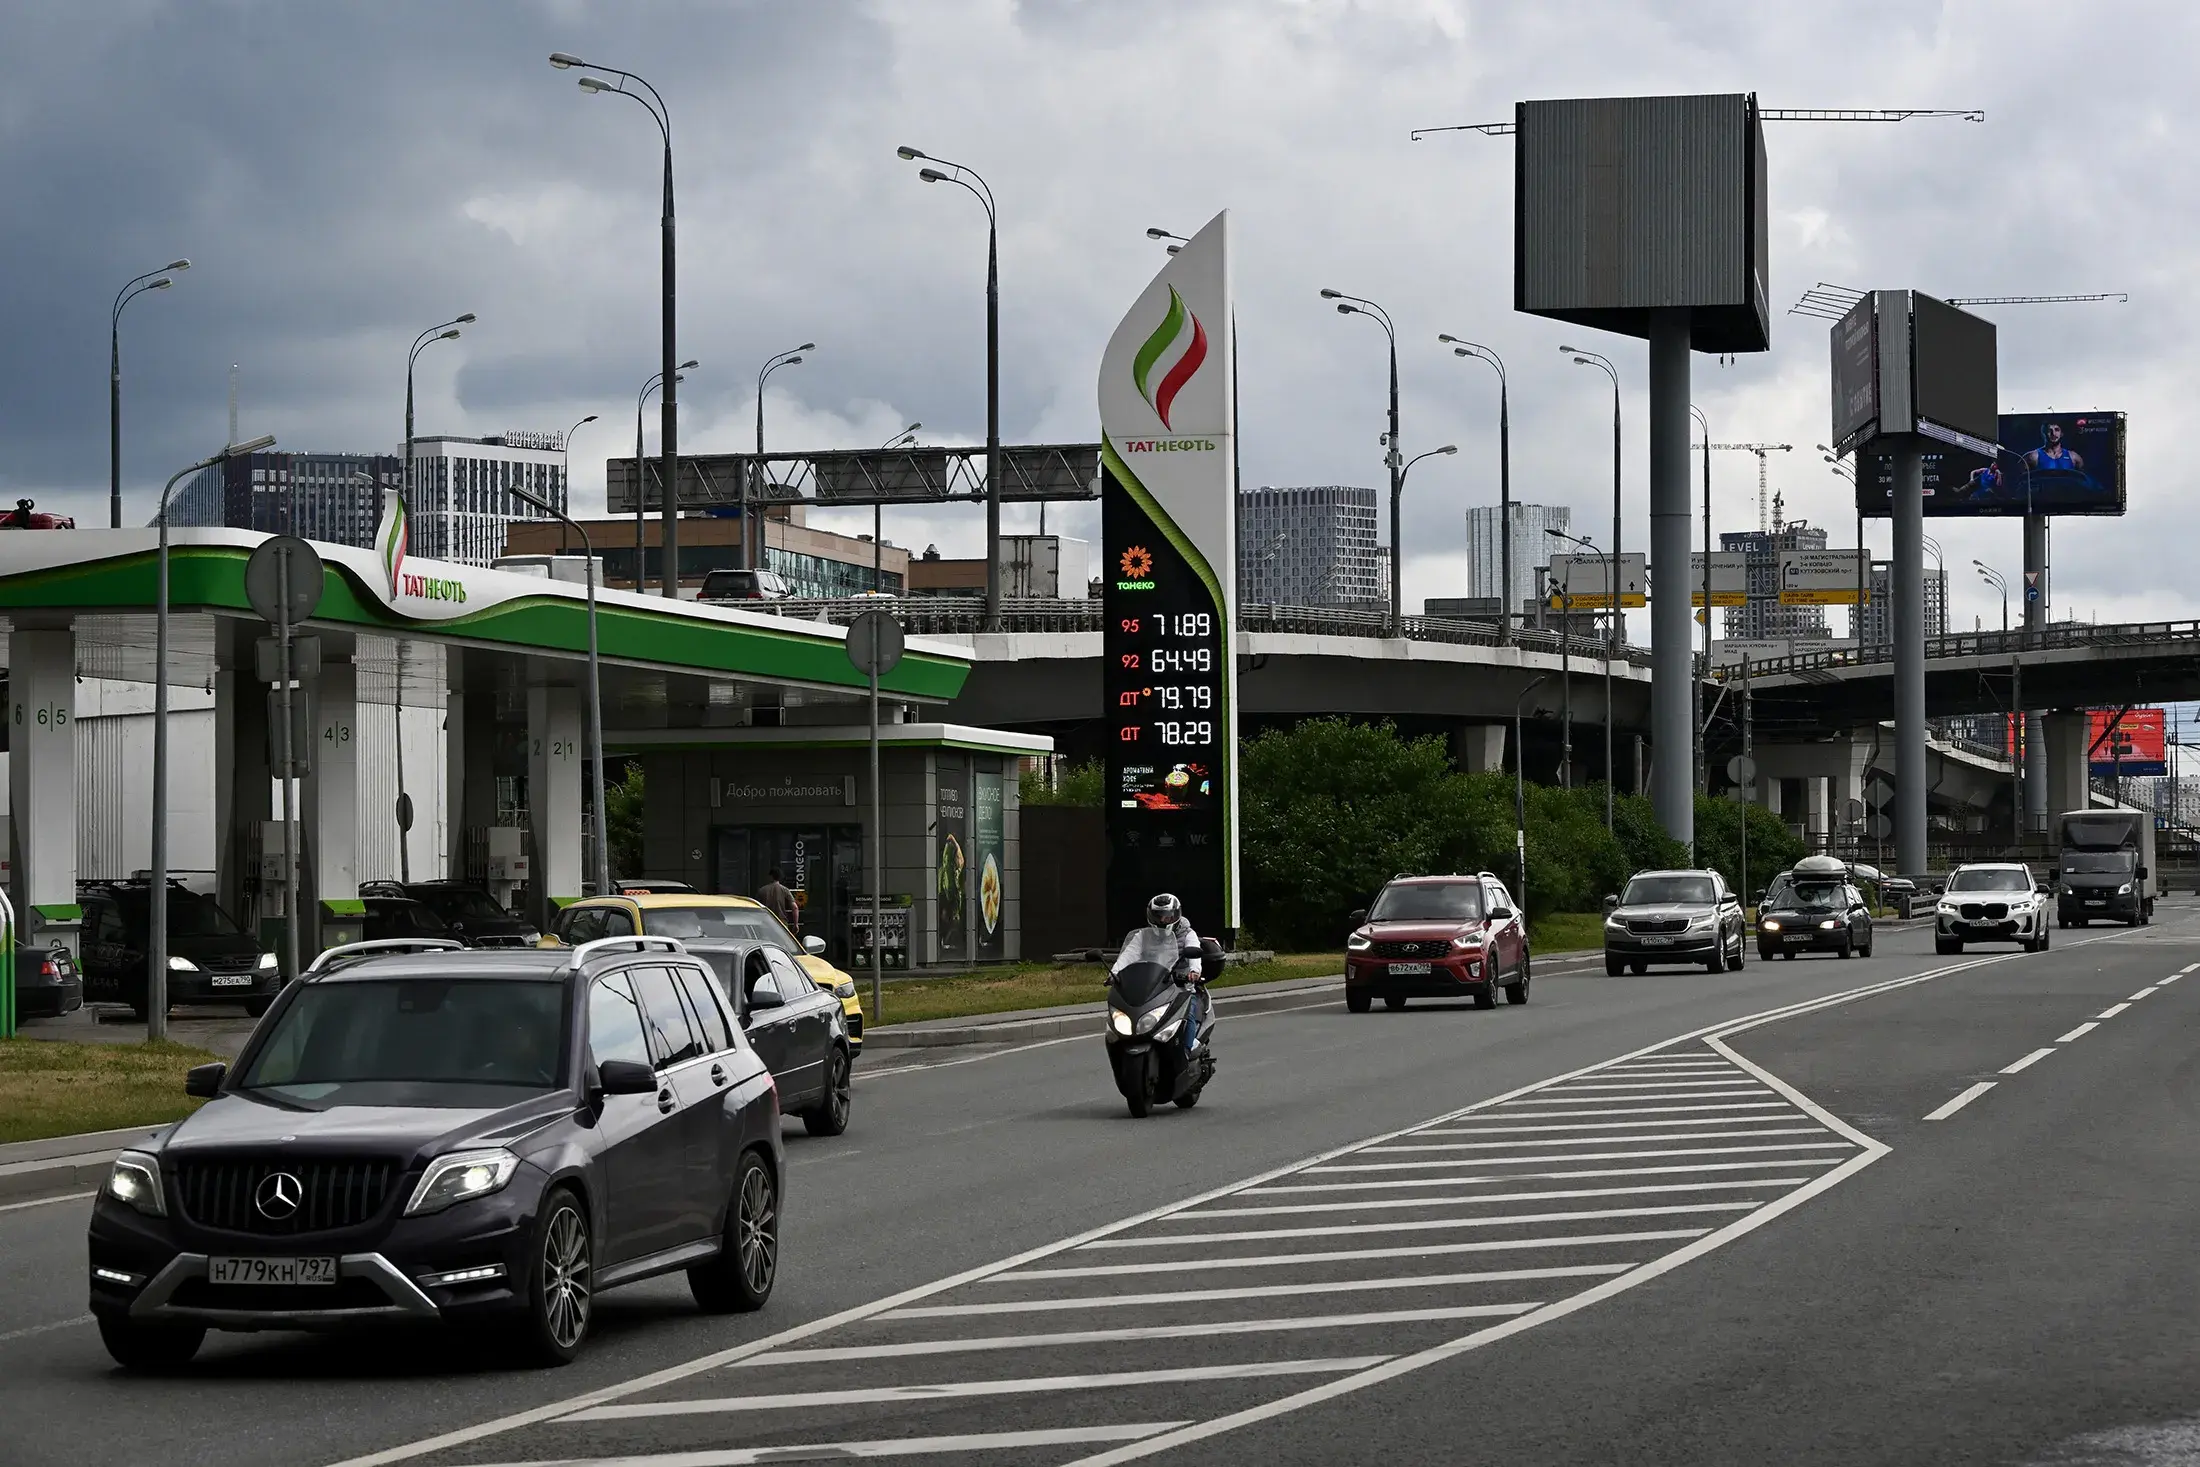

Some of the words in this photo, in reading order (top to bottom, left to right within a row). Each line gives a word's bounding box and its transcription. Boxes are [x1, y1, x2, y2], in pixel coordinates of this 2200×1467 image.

[1125, 440, 1216, 453] ТАТНЕФТЬ
[1722, 542, 1760, 552] LEVEL
[403, 573, 467, 603] ТАТНЕФТЬ
[1117, 582, 1155, 590] ТАНЕКО
[1121, 619, 1140, 632] 95
[1153, 613, 1210, 636] 71.89
[1121, 654, 1140, 668] 92
[1151, 648, 1210, 672] 64.49
[1119, 691, 1140, 706] ДТ
[1154, 686, 1211, 709] 79.79
[1120, 727, 1141, 741] ДТ
[1154, 721, 1212, 745] 78.29
[727, 783, 766, 800] Добро
[1190, 834, 1209, 845] WC
[215, 1259, 294, 1282] Н779КН
[298, 1258, 331, 1276] 797
